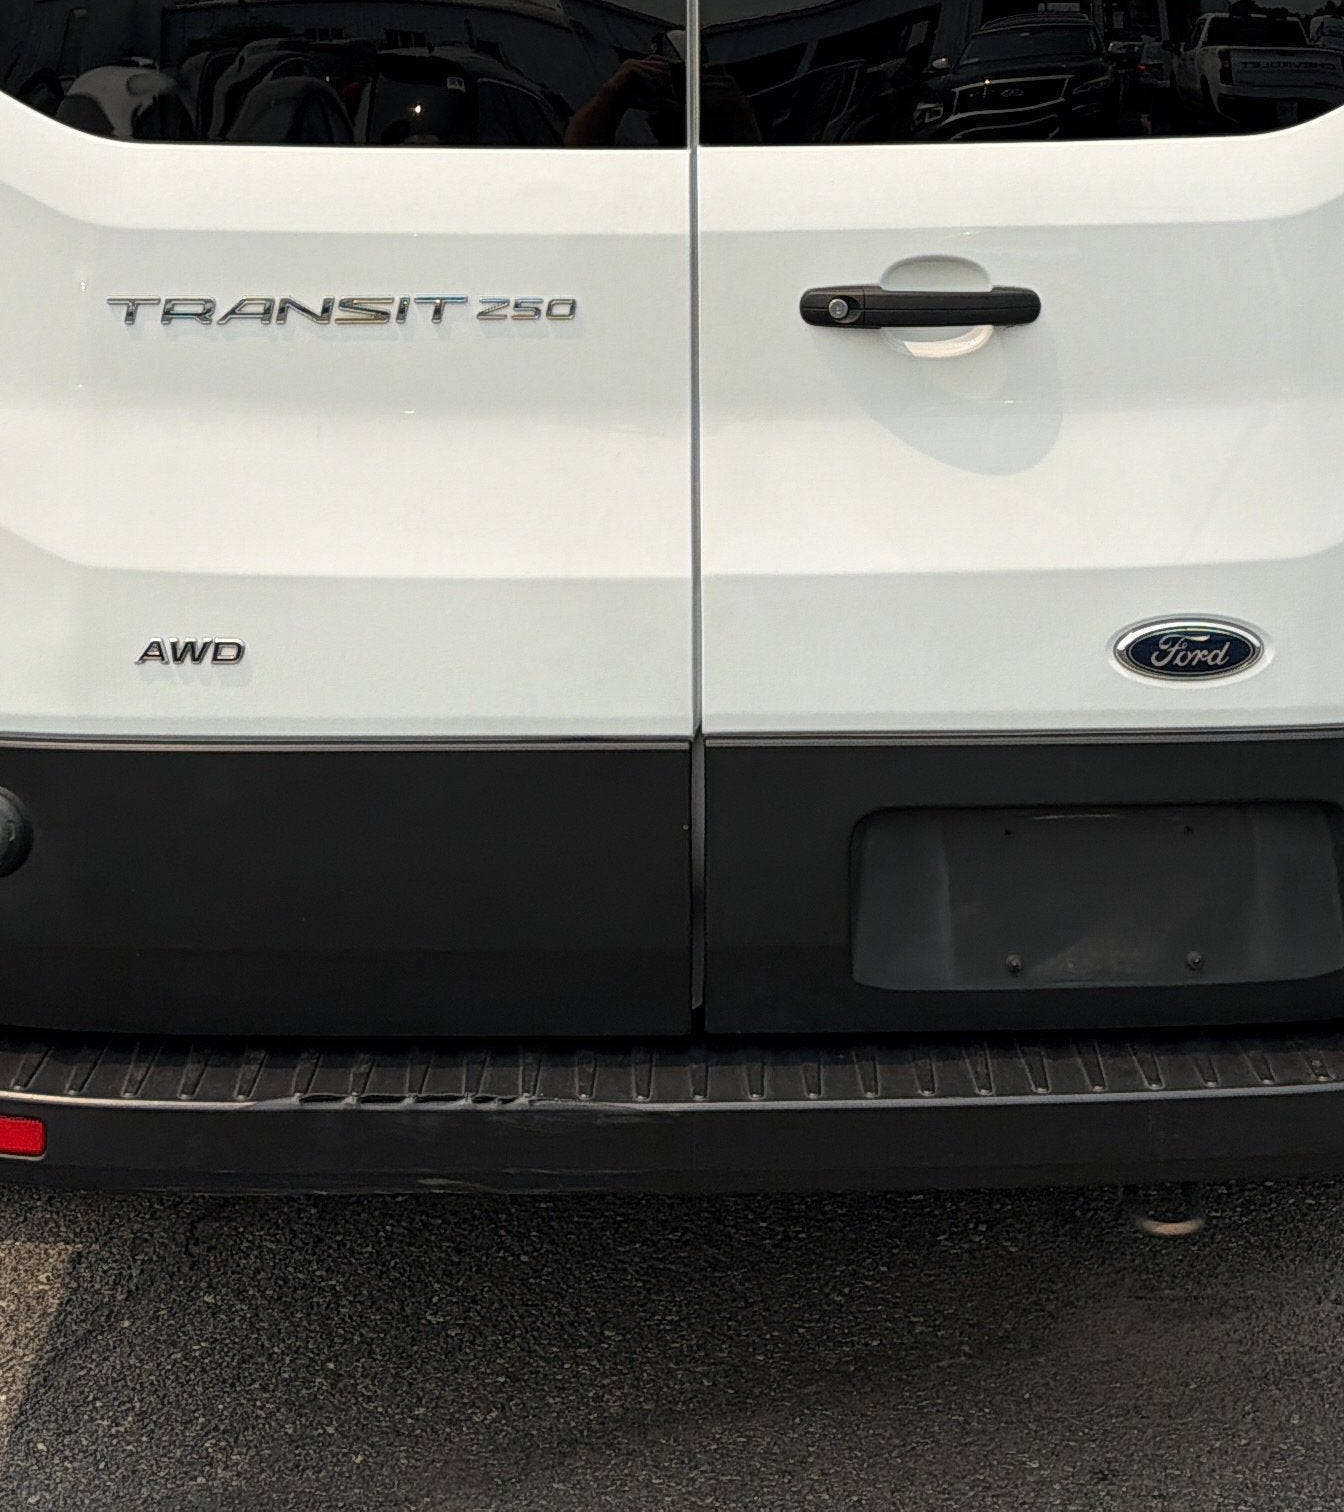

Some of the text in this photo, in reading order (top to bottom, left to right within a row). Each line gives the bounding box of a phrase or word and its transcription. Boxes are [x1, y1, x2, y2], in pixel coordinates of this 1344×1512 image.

[106, 295, 577, 325] TRANSIT 250
[134, 637, 246, 665] AWD
[1150, 634, 1232, 667] Ford
